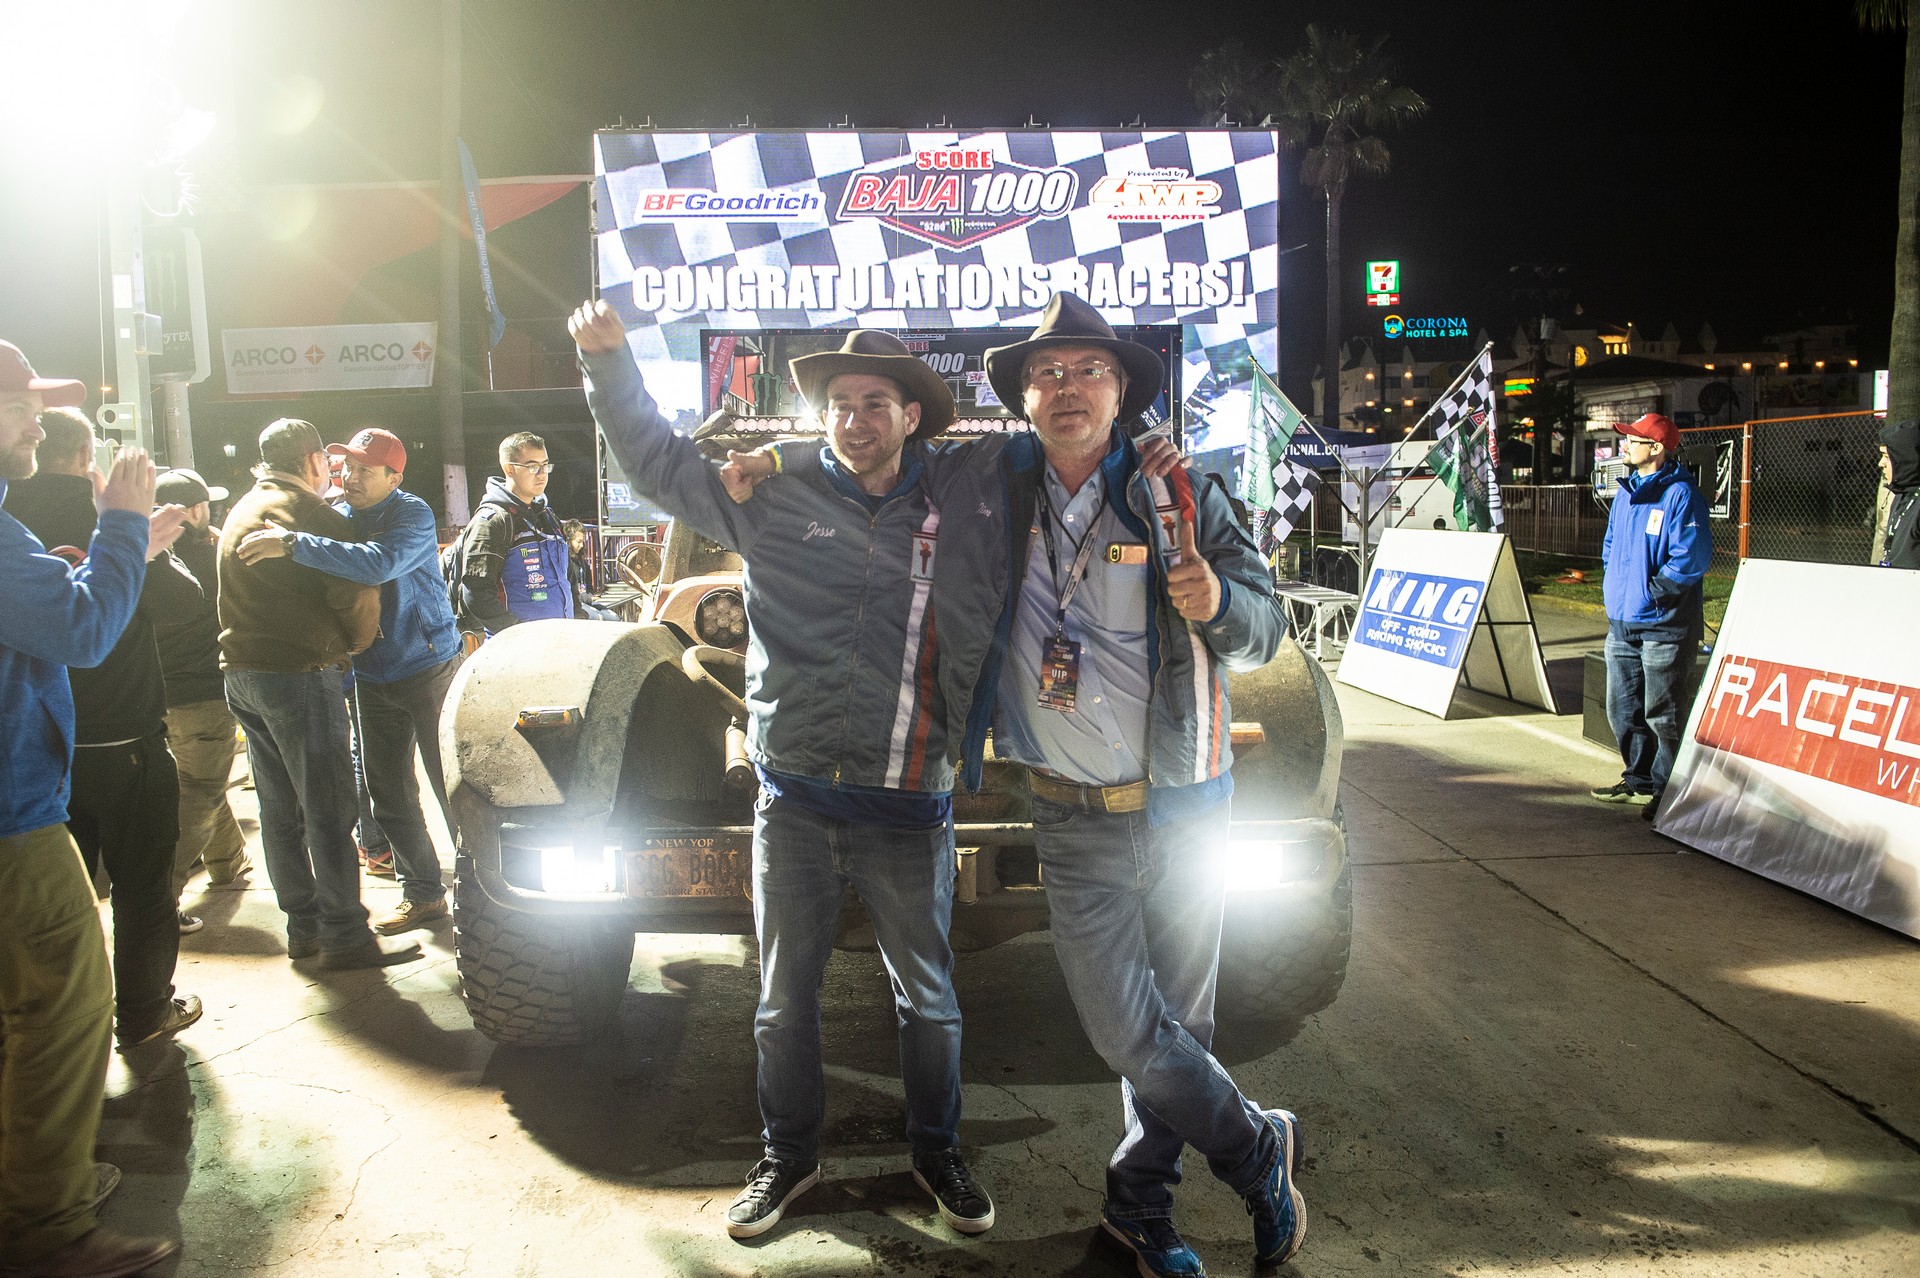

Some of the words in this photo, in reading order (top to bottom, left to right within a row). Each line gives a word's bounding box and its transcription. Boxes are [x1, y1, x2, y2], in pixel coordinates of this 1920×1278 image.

[918, 151, 992, 168] SCORE
[1174, 170, 1185, 178] by
[847, 174, 960, 211] BAJA
[970, 172, 1072, 212] 1000
[644, 193, 819, 210] BFGoodrich
[632, 262, 1051, 311] CONGRATULATIONS
[1051, 261, 1245, 307] RACERS!
[1406, 317, 1468, 329] CORONA
[162, 331, 191, 344] STER
[1406, 330, 1436, 338] HOTEL
[1449, 328, 1468, 337] SPA
[905, 341, 929, 351] ORE
[231, 346, 298, 367] ARCO
[338, 342, 405, 363] ARCO
[289, 367, 303, 375] TOP
[398, 363, 409, 371] TOP
[1285, 444, 1349, 456] TIONAL.CO
[976, 502, 992, 518] Jim
[803, 521, 837, 541] Jesse
[1367, 576, 1480, 624] KING
[1381, 619, 1401, 632] OFF
[1407, 625, 1441, 641] ROAD
[1366, 628, 1404, 647] RACING
[1404, 637, 1447, 657] SHOCKS
[655, 838, 687, 848] NEW
[690, 838, 715, 848] YOR
